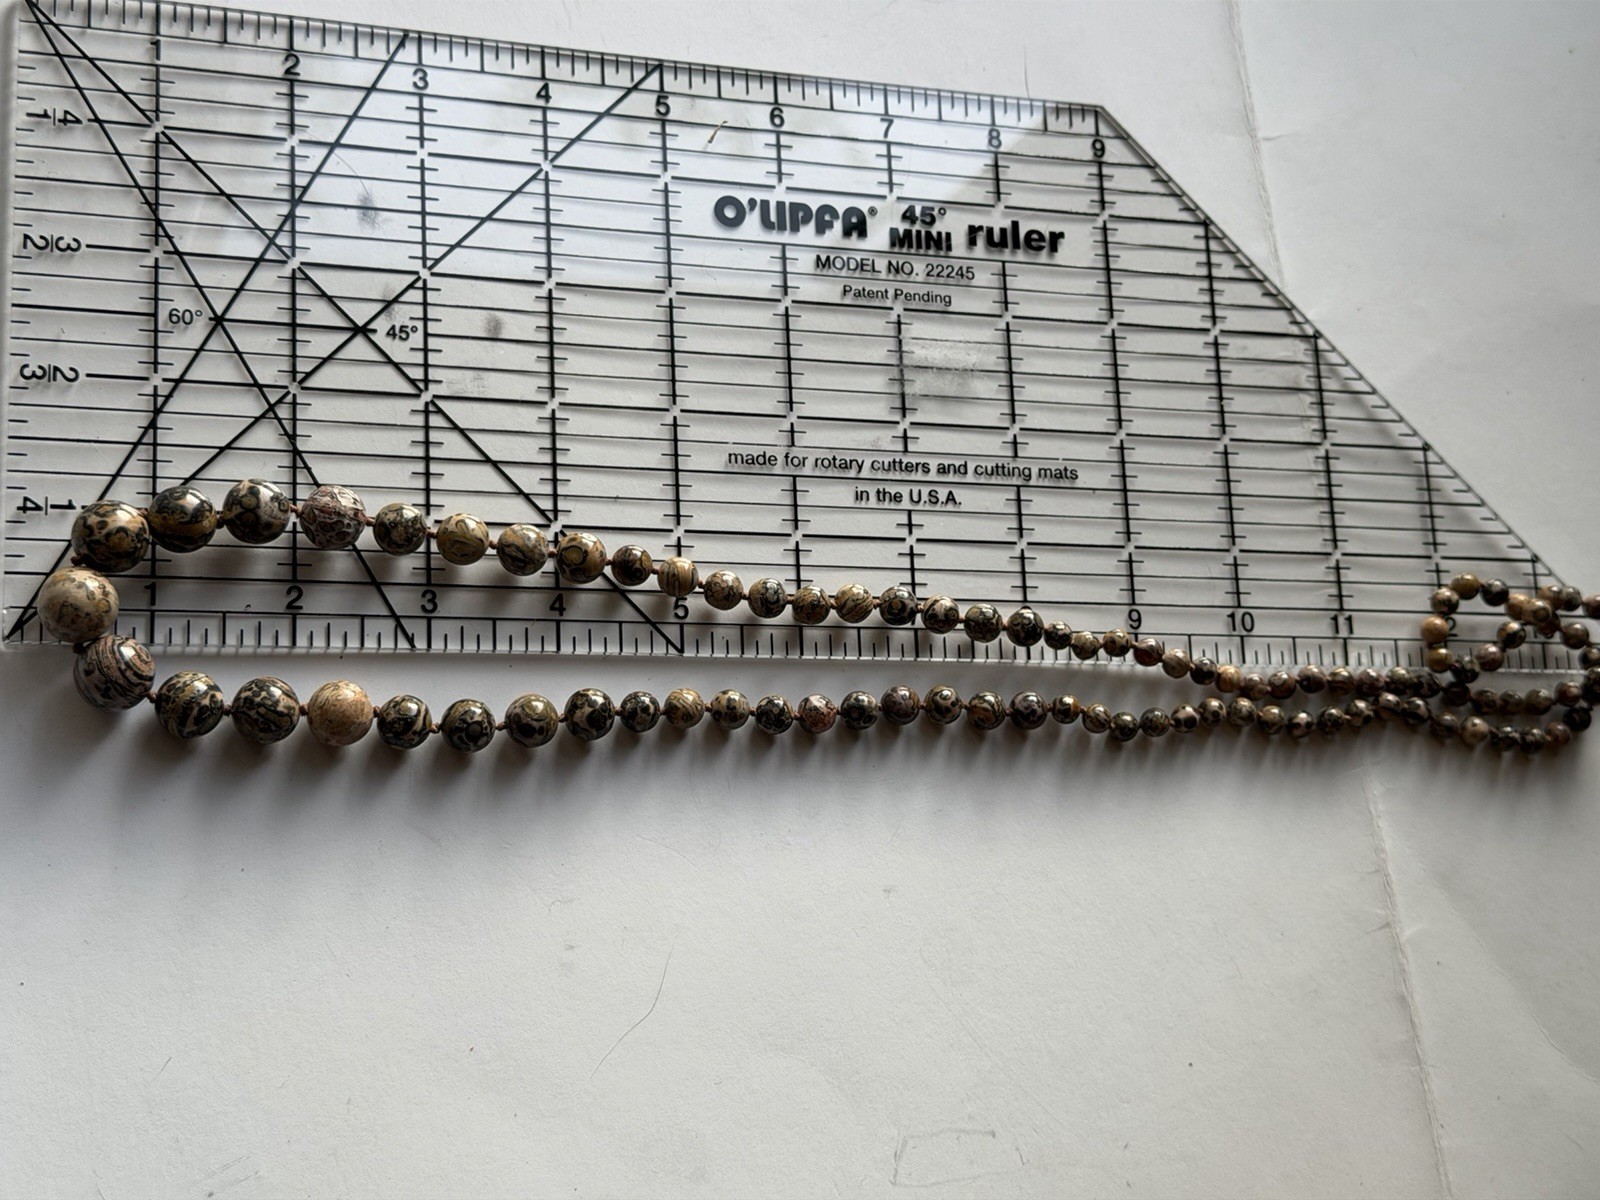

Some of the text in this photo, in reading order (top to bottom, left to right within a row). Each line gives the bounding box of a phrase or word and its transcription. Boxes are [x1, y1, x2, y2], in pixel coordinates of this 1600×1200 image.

[284, 53, 301, 76] 2
[412, 67, 429, 91] 3
[535, 82, 552, 103] 4
[655, 95, 671, 116] 5
[769, 107, 785, 128] 6
[880, 117, 895, 139] 7
[988, 128, 1002, 149] 8
[1091, 138, 1106, 159] 9
[889, 227, 952, 252] MINI
[967, 220, 1065, 253] ruler
[815, 254, 975, 280] MODEL NO. 22245
[842, 284, 952, 307] Patent Pending
[727, 450, 1079, 482] made for rotary cutters and cutting mats
[854, 486, 963, 507] in the U.S.A.
[286, 586, 303, 609] 2
[420, 589, 438, 614] 3
[549, 593, 566, 616] 4
[673, 596, 690, 620] 5
[1128, 608, 1142, 630] 9
[1226, 611, 1255, 633] 10
[1330, 614, 1354, 635] 11
